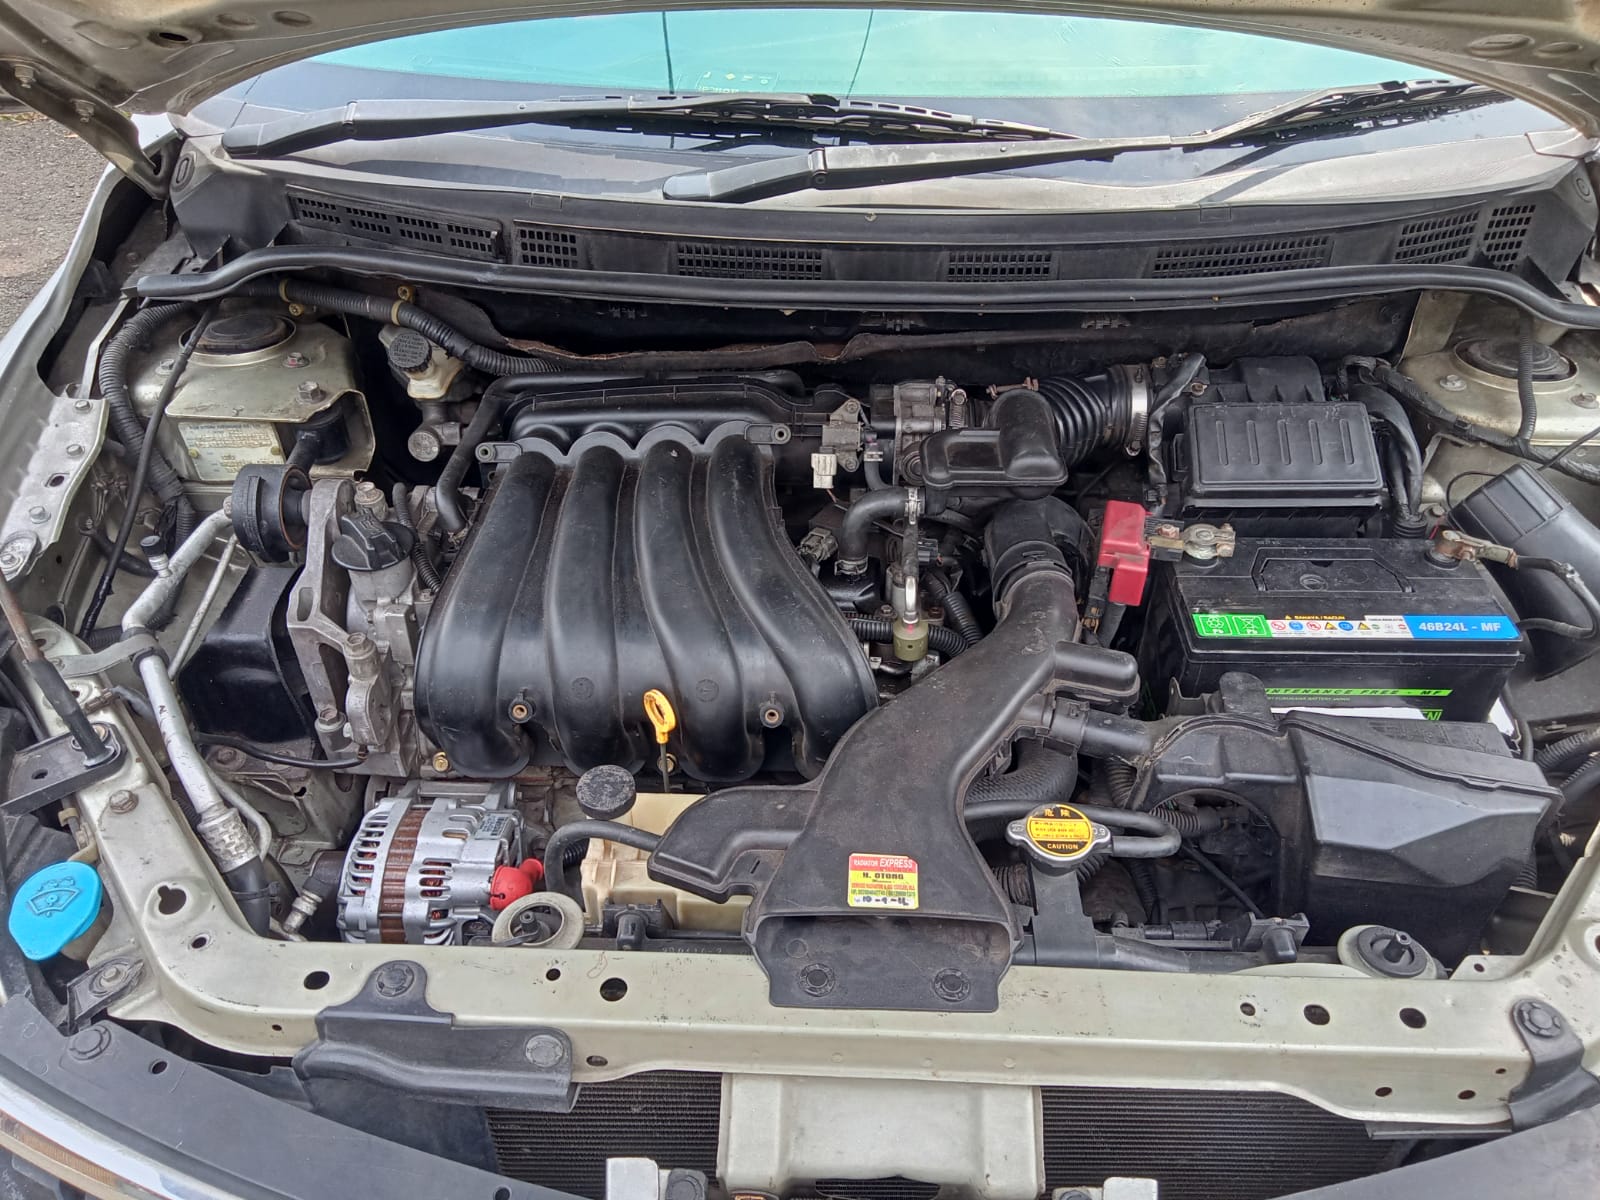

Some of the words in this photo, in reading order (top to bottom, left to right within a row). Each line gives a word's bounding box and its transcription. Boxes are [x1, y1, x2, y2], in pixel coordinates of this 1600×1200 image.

[1418, 622, 1468, 632] 46B24L
[1480, 622, 1501, 632] MF
[880, 858, 913, 868] EXPRESS
